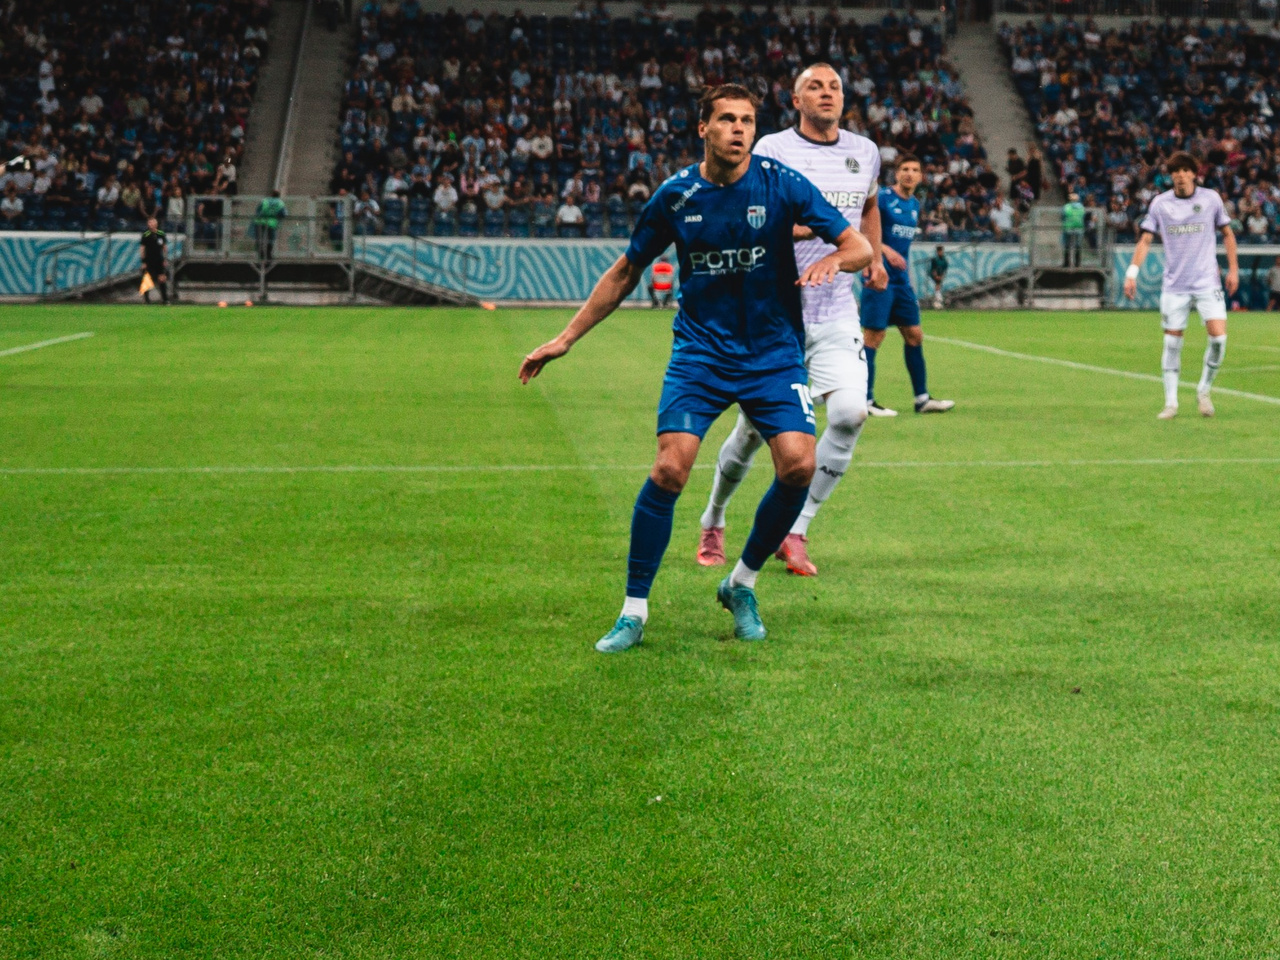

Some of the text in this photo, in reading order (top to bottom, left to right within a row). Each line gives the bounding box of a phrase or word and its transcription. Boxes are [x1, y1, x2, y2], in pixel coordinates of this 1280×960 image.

[671, 182, 702, 212] legalbet
[822, 191, 867, 208] NBET
[684, 215, 703, 223] JAKO
[689, 246, 766, 270] РОТОР
